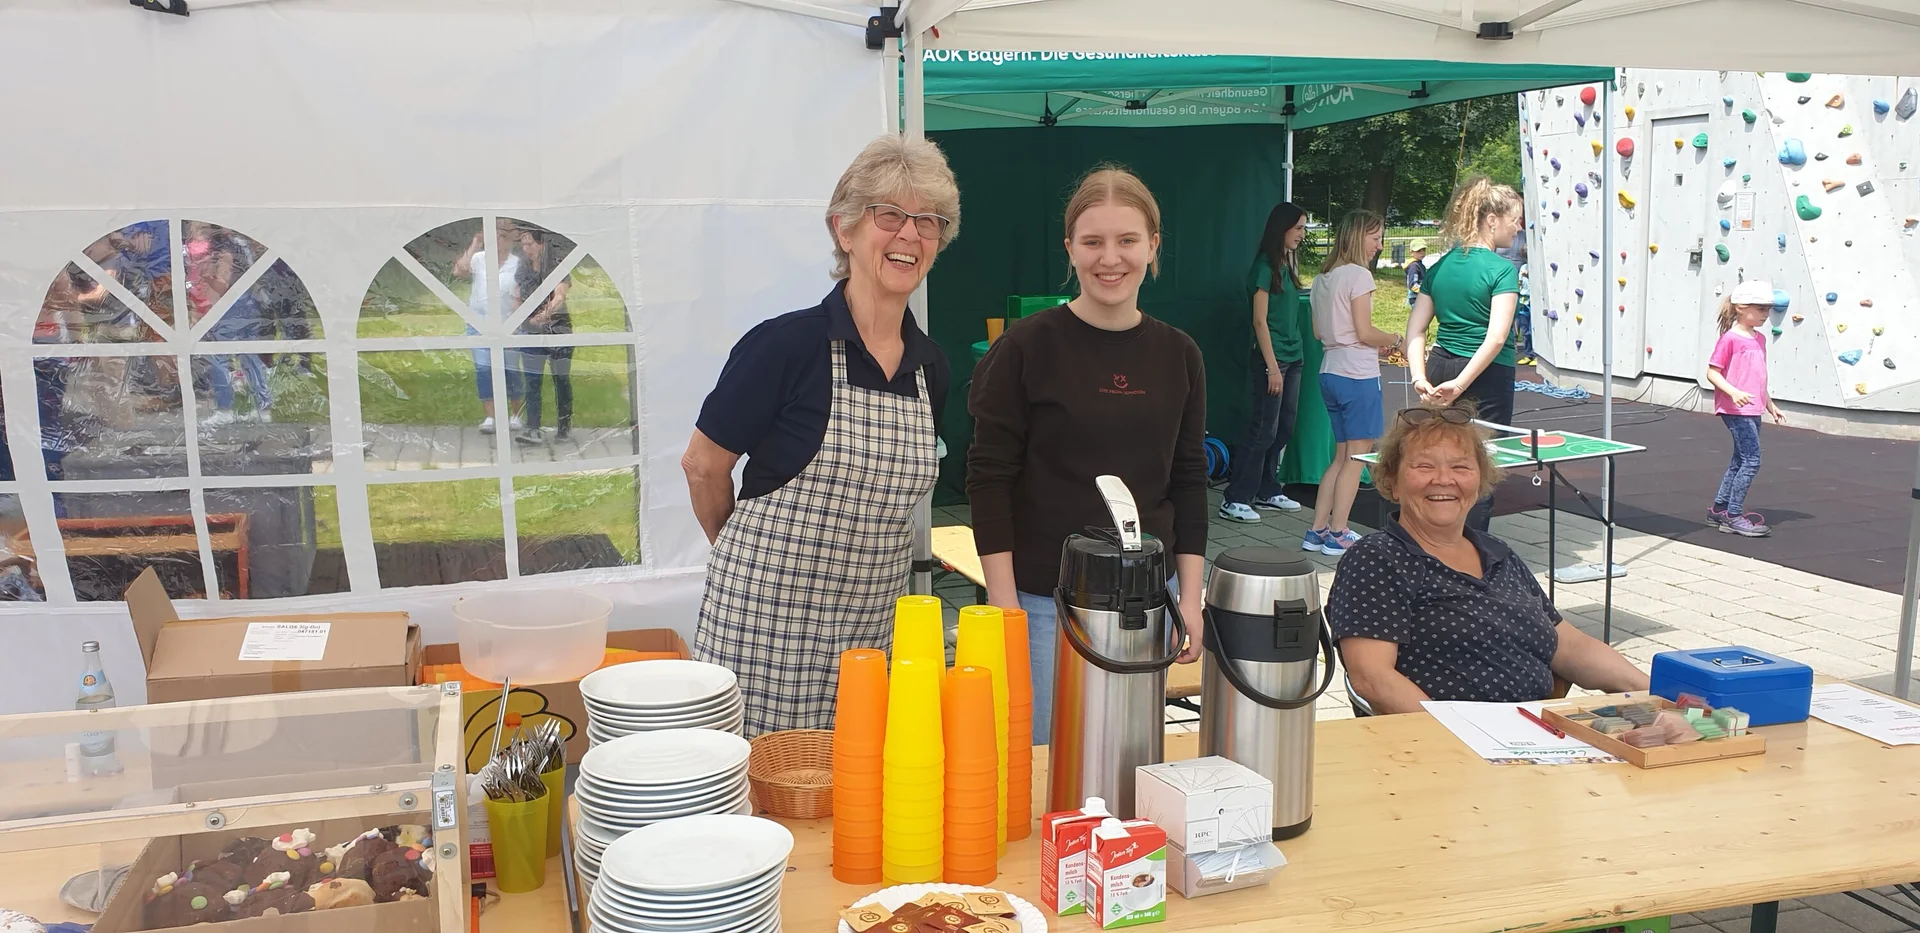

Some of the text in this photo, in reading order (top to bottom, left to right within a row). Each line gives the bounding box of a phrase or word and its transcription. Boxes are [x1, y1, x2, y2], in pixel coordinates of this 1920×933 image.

[923, 49, 964, 62] AOK
[968, 51, 1036, 66] Bayern.
[1041, 51, 1069, 61] Die
[1194, 830, 1213, 839] RPC
